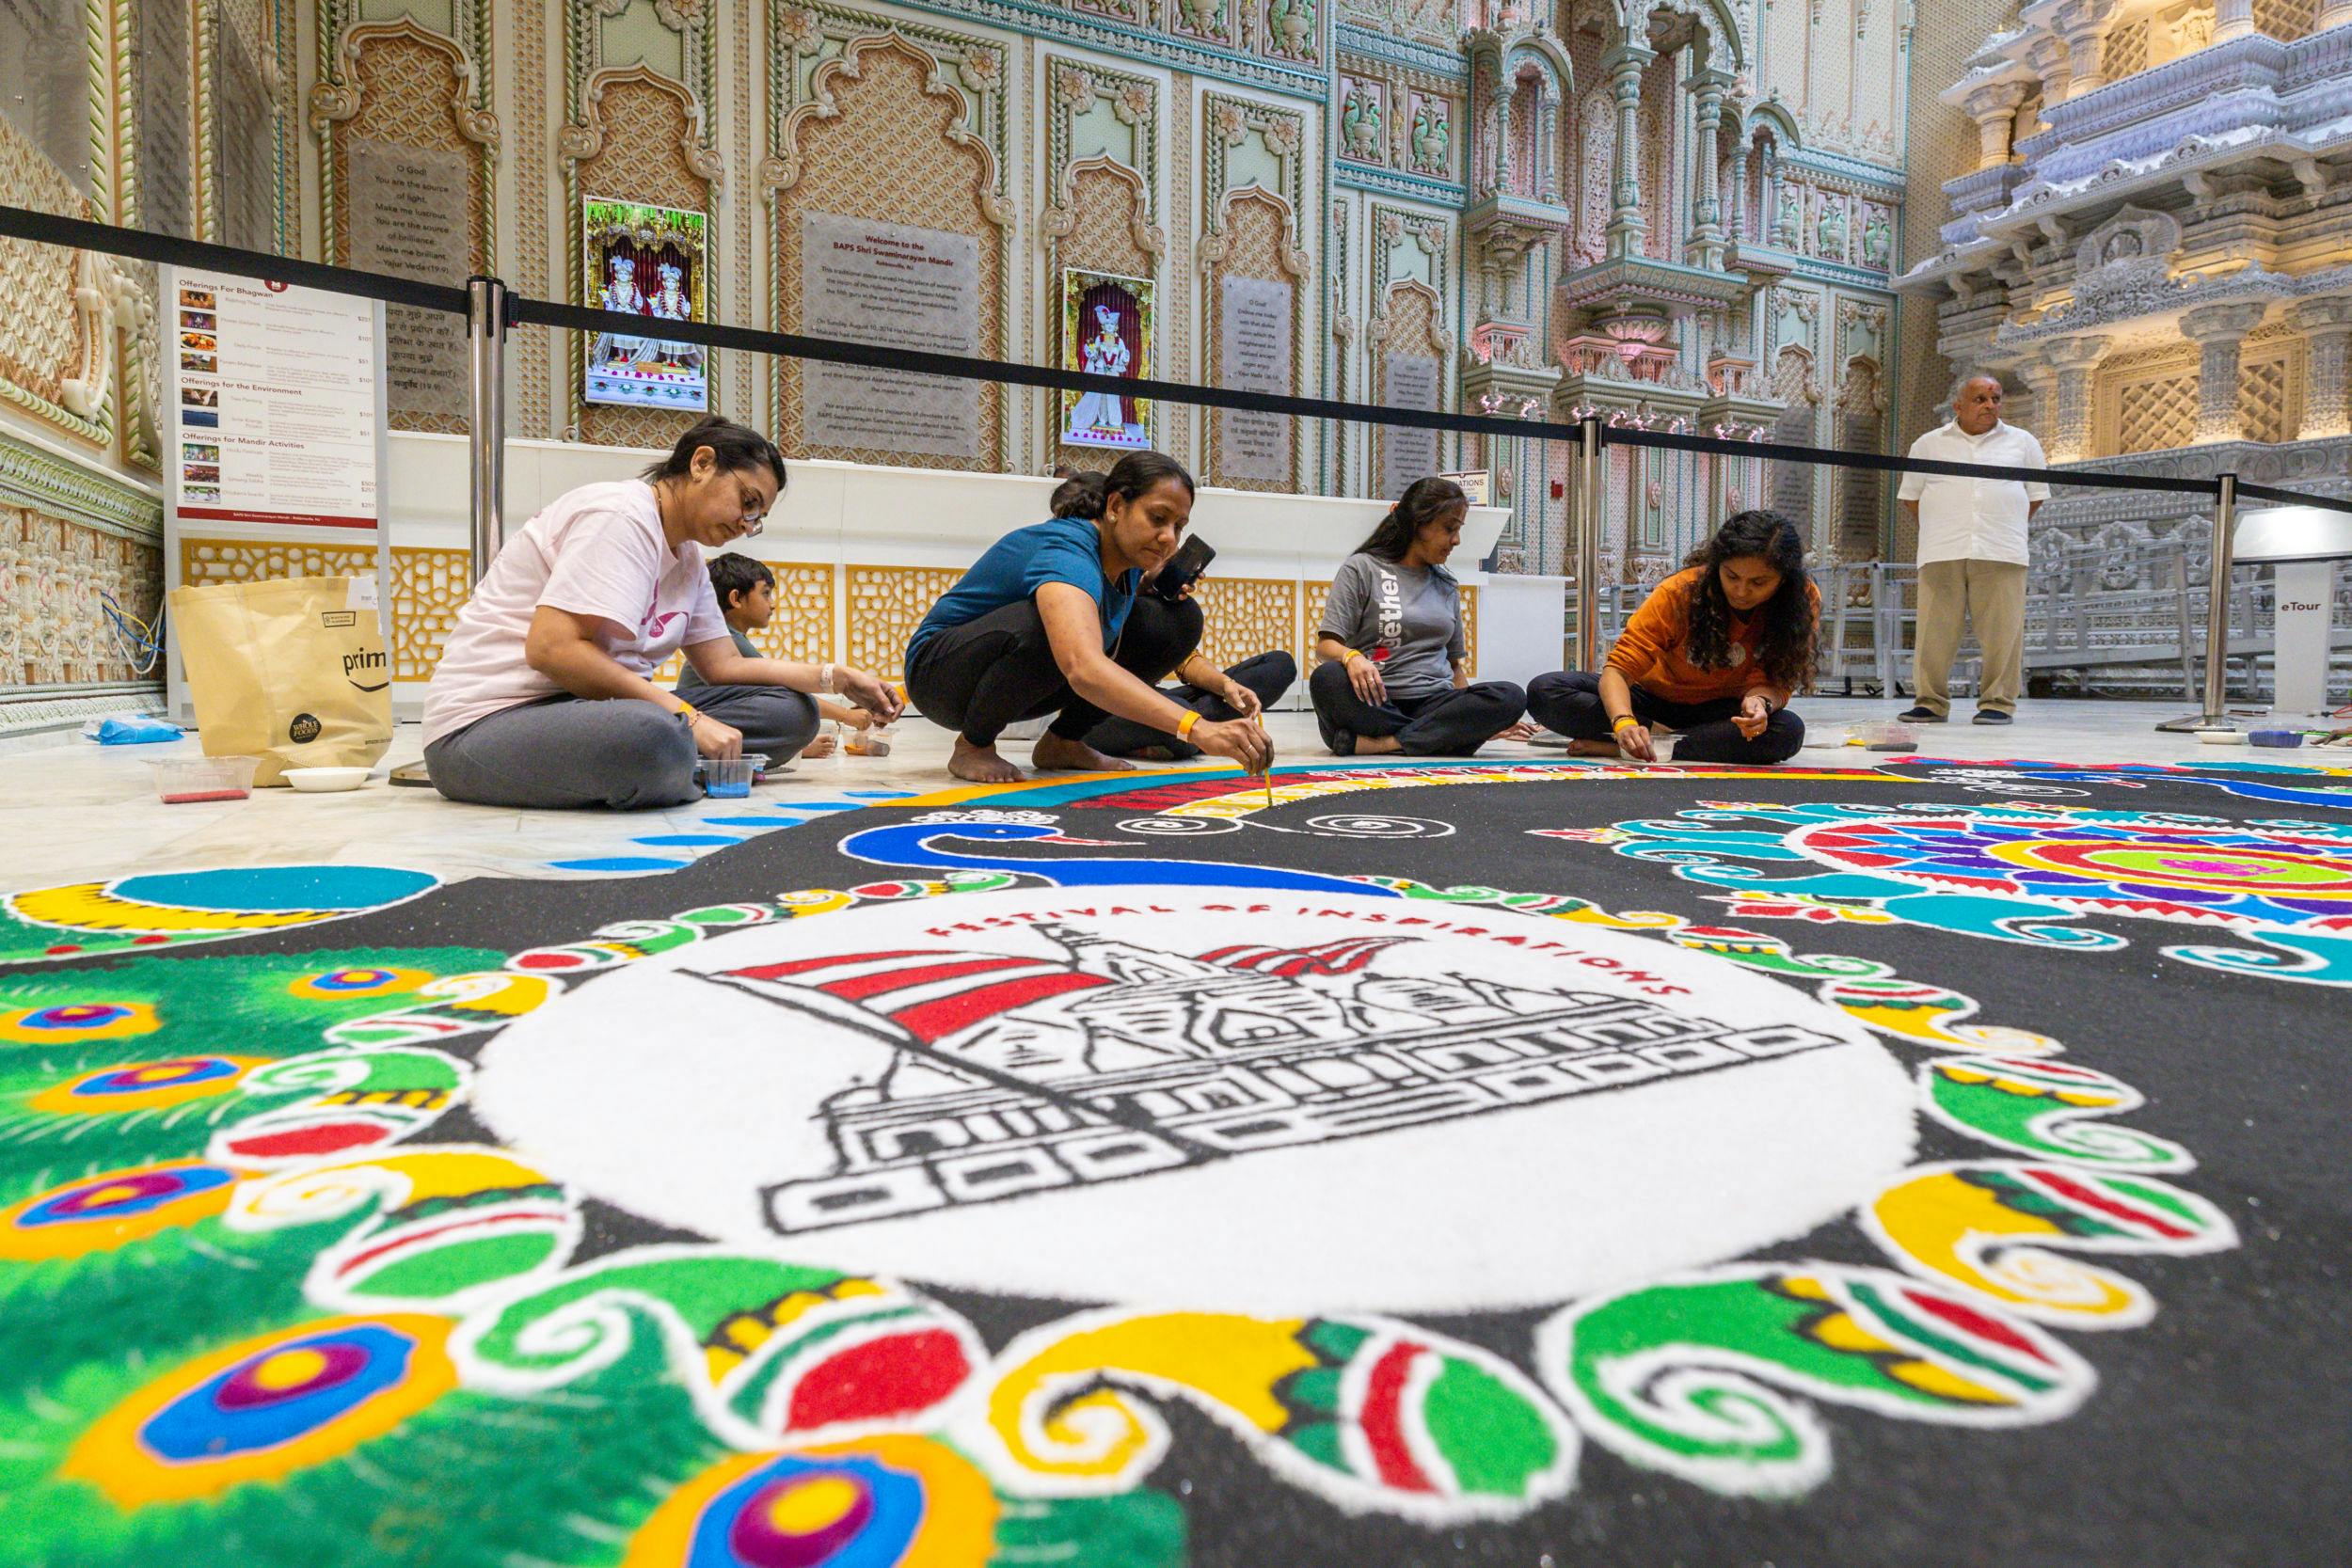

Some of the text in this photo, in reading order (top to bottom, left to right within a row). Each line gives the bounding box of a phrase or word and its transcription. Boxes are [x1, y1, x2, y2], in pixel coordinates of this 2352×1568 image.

[407, 166, 426, 176] God!
[375, 175, 389, 183] You
[422, 183, 449, 192] source
[375, 203, 397, 213] Make
[375, 216, 389, 225] You
[423, 225, 449, 233] source
[866, 235, 899, 246] Welcome
[376, 245, 398, 254] Make
[834, 242, 954, 266] BAPS Shri Swaminarayan Mandir
[383, 259, 403, 268] Yajur
[405, 262, 425, 271] Veda
[179, 279, 217, 291] Offerings
[236, 288, 273, 298] Bhagwan
[182, 377, 220, 387] Offerings
[252, 385, 301, 395] Environment
[183, 433, 221, 443] Offerings
[238, 437, 265, 446] Mandir
[268, 440, 305, 449] Activities
[2281, 602, 2321, 610] eTour
[342, 647, 387, 676] prim
[294, 721, 318, 730] WHOLE
[294, 727, 318, 736] FOODS
[924, 904, 1692, 996] FESTIVAL OF INSPIRATIONS
